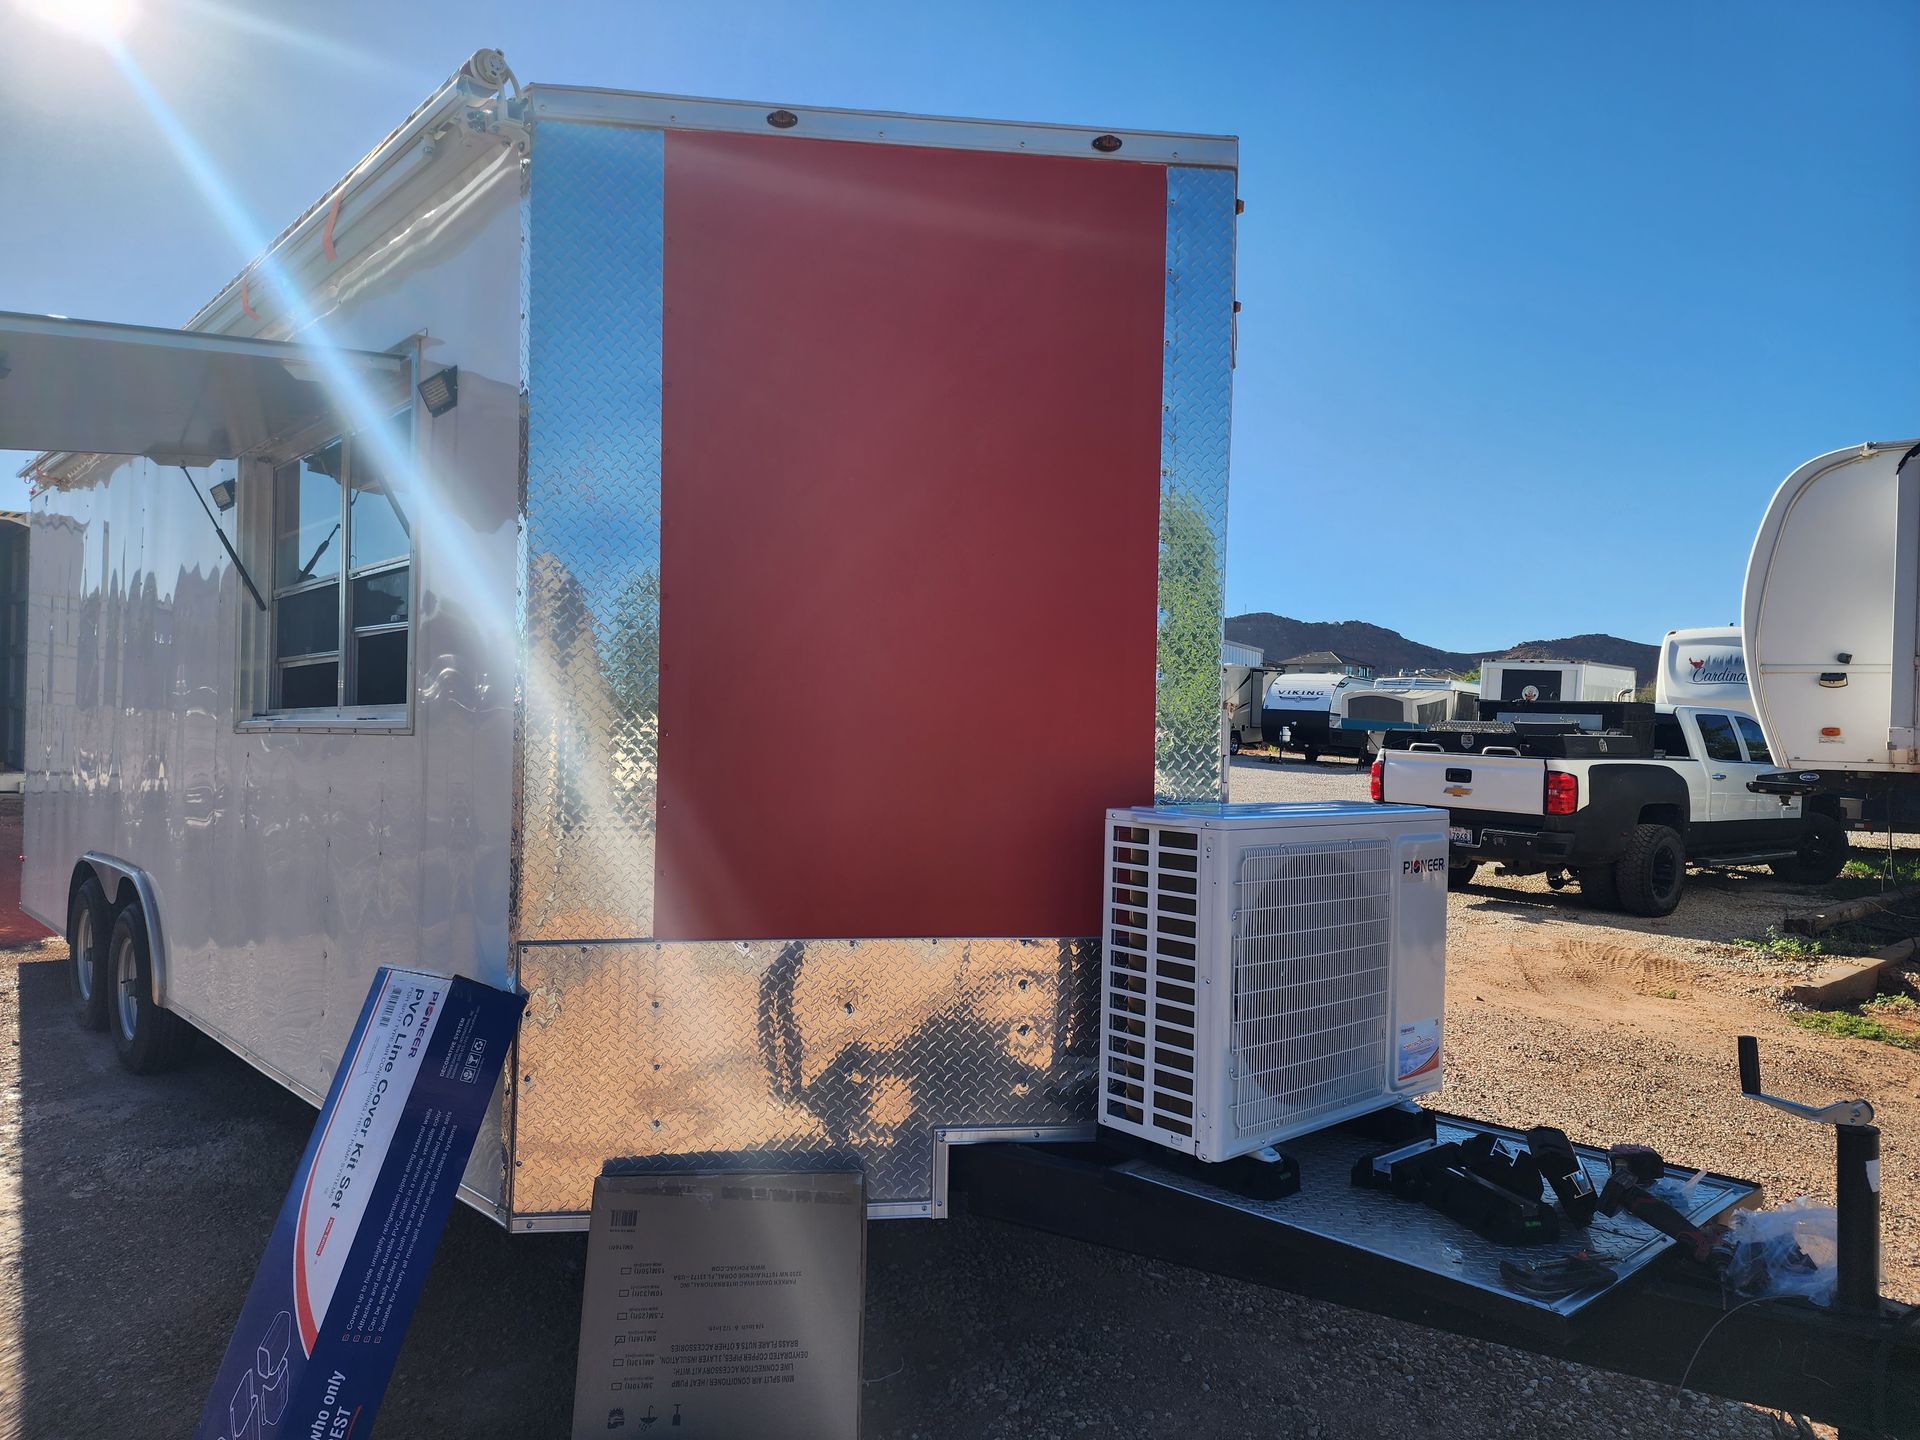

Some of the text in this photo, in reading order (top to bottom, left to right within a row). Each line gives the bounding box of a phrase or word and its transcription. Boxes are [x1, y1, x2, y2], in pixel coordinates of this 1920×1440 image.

[1692, 667, 1748, 683] Cardina
[1403, 857, 1445, 875] PIONEER
[402, 988, 424, 1027] PVC
[407, 991, 439, 1057] PIONEER
[384, 1033, 406, 1072] Line
[439, 1041, 456, 1076] DECORATIVE
[360, 1079, 388, 1137] Cover
[422, 1108, 432, 1124] walls
[346, 1142, 364, 1169] Kit
[405, 1153, 416, 1172] along
[397, 1173, 408, 1193] pipes
[330, 1175, 350, 1209] Set
[357, 1297, 373, 1331] Attractive
[370, 1281, 378, 1296] and
[375, 1265, 385, 1281] ultra
[382, 1237, 395, 1264] durable
[390, 1219, 401, 1236] PVC
[398, 1196, 410, 1220] plastic
[422, 1127, 435, 1155] versatile
[432, 1109, 441, 1127] color
[367, 1111, 452, 1331] Can be easily added to both new and previously installed pipe sets
[382, 1193, 400, 1234] refrigeration
[377, 1303, 392, 1332] Suitable
[388, 1292, 396, 1302] for
[393, 1269, 405, 1291] nearly
[416, 1213, 425, 1227] and
[433, 1152, 447, 1180] ductless
[444, 1124, 457, 1151] systems
[370, 1235, 385, 1266] unsightly
[363, 1268, 373, 1283] hide
[360, 1284, 367, 1292] to
[356, 1293, 364, 1303] up
[346, 1304, 360, 1330] Covers
[670, 1343, 712, 1352] ACCESSORIES
[713, 1342, 734, 1350] OTHER
[740, 1341, 756, 1350] NUTS
[757, 1340, 777, 1349] FLARE
[778, 1339, 798, 1348] BRASS
[697, 1354, 717, 1362] LAYER
[743, 1352, 767, 1361] COPPER
[768, 1350, 808, 1360] DEHYDRATED
[702, 1365, 739, 1374] ACCESSORY
[740, 1363, 779, 1372] CONNECTION
[779, 1363, 793, 1371] LINE
[671, 1379, 688, 1387] PUMP
[689, 1378, 705, 1386] HEAT
[709, 1376, 750, 1386] CONDITIONER
[751, 1376, 762, 1384] AIR
[763, 1375, 780, 1383] SPLIT
[323, 1370, 346, 1406] only
[328, 1405, 351, 1440] EST
